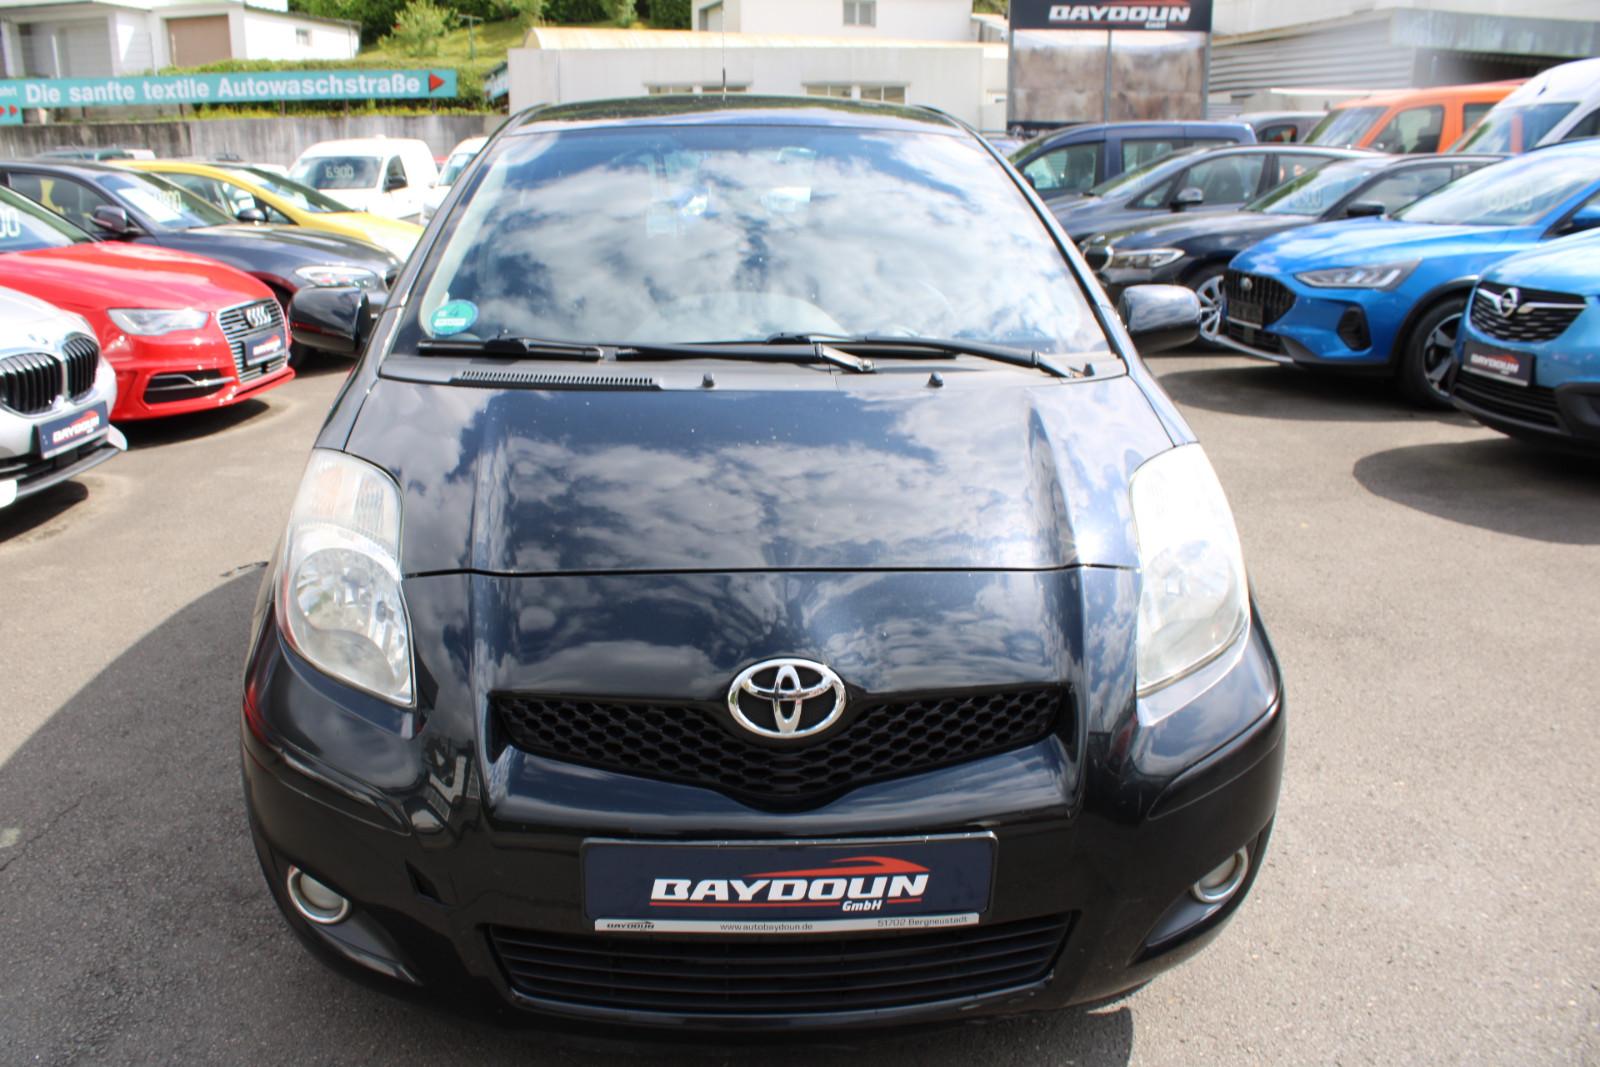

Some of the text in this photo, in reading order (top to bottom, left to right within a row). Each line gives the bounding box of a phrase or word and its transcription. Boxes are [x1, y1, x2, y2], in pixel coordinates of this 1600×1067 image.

[1049, 5, 1191, 22] BAYDOUN
[25, 74, 420, 103] Die sanfte textile Autowaschstraße
[650, 874, 929, 901] BAYDOUN
[842, 900, 882, 912] GmbH
[720, 923, 813, 931] www.autobaydoun.de
[908, 915, 967, 927] Bergneustadt
